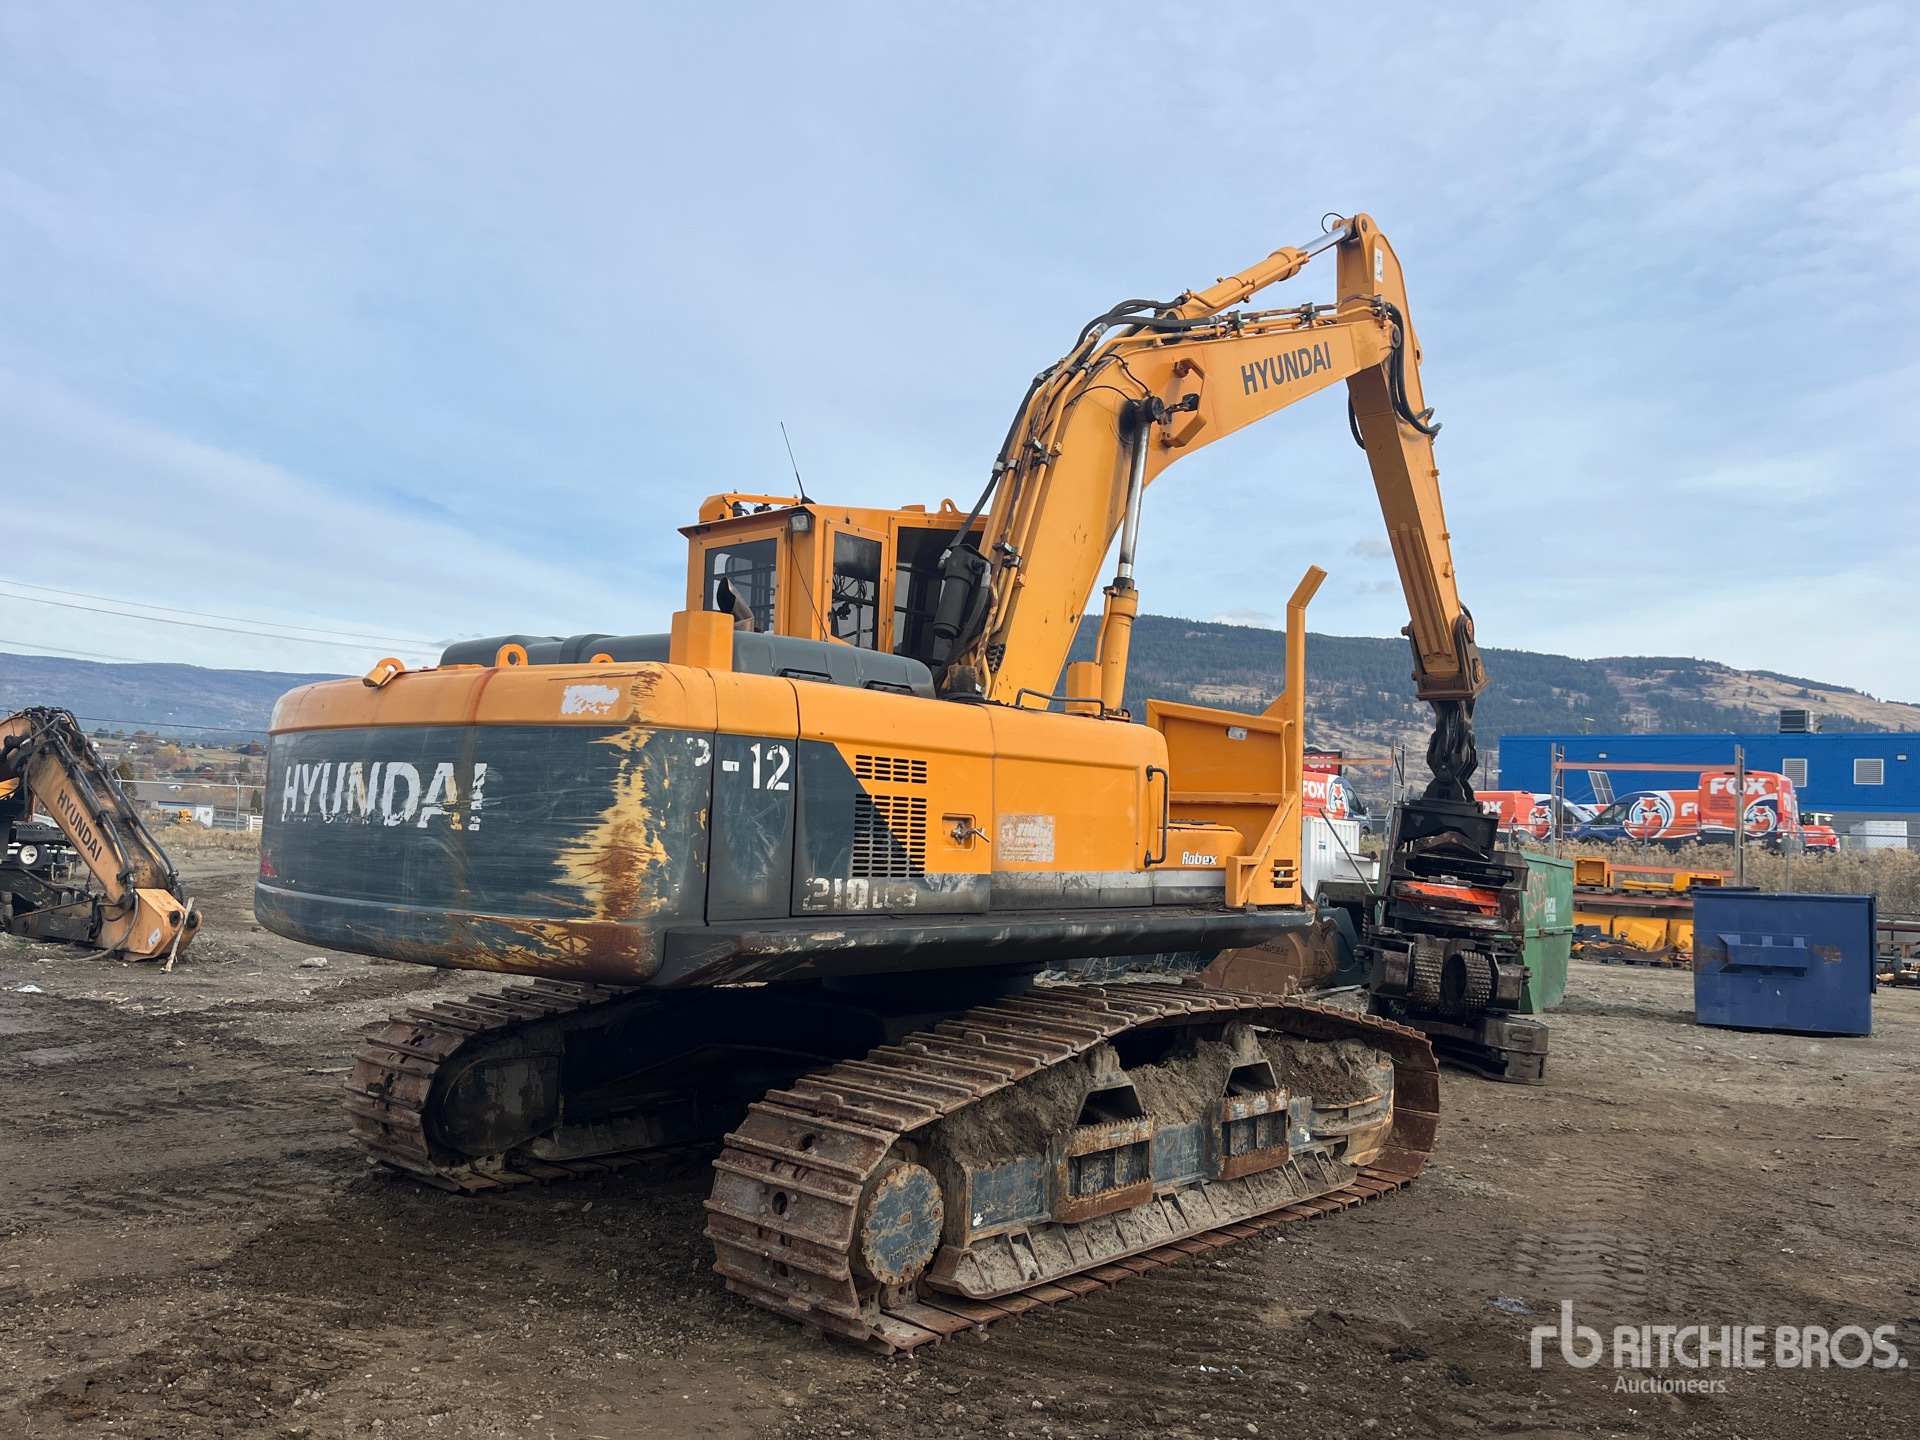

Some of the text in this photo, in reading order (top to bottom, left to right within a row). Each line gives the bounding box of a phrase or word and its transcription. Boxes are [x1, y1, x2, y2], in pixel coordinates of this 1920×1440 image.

[1240, 341, 1332, 395] HYUNDAI
[281, 761, 488, 831] HYUNDAI
[1710, 777, 1767, 795] FOX
[57, 788, 102, 862] HYUNDAI
[1181, 851, 1219, 866] Robex
